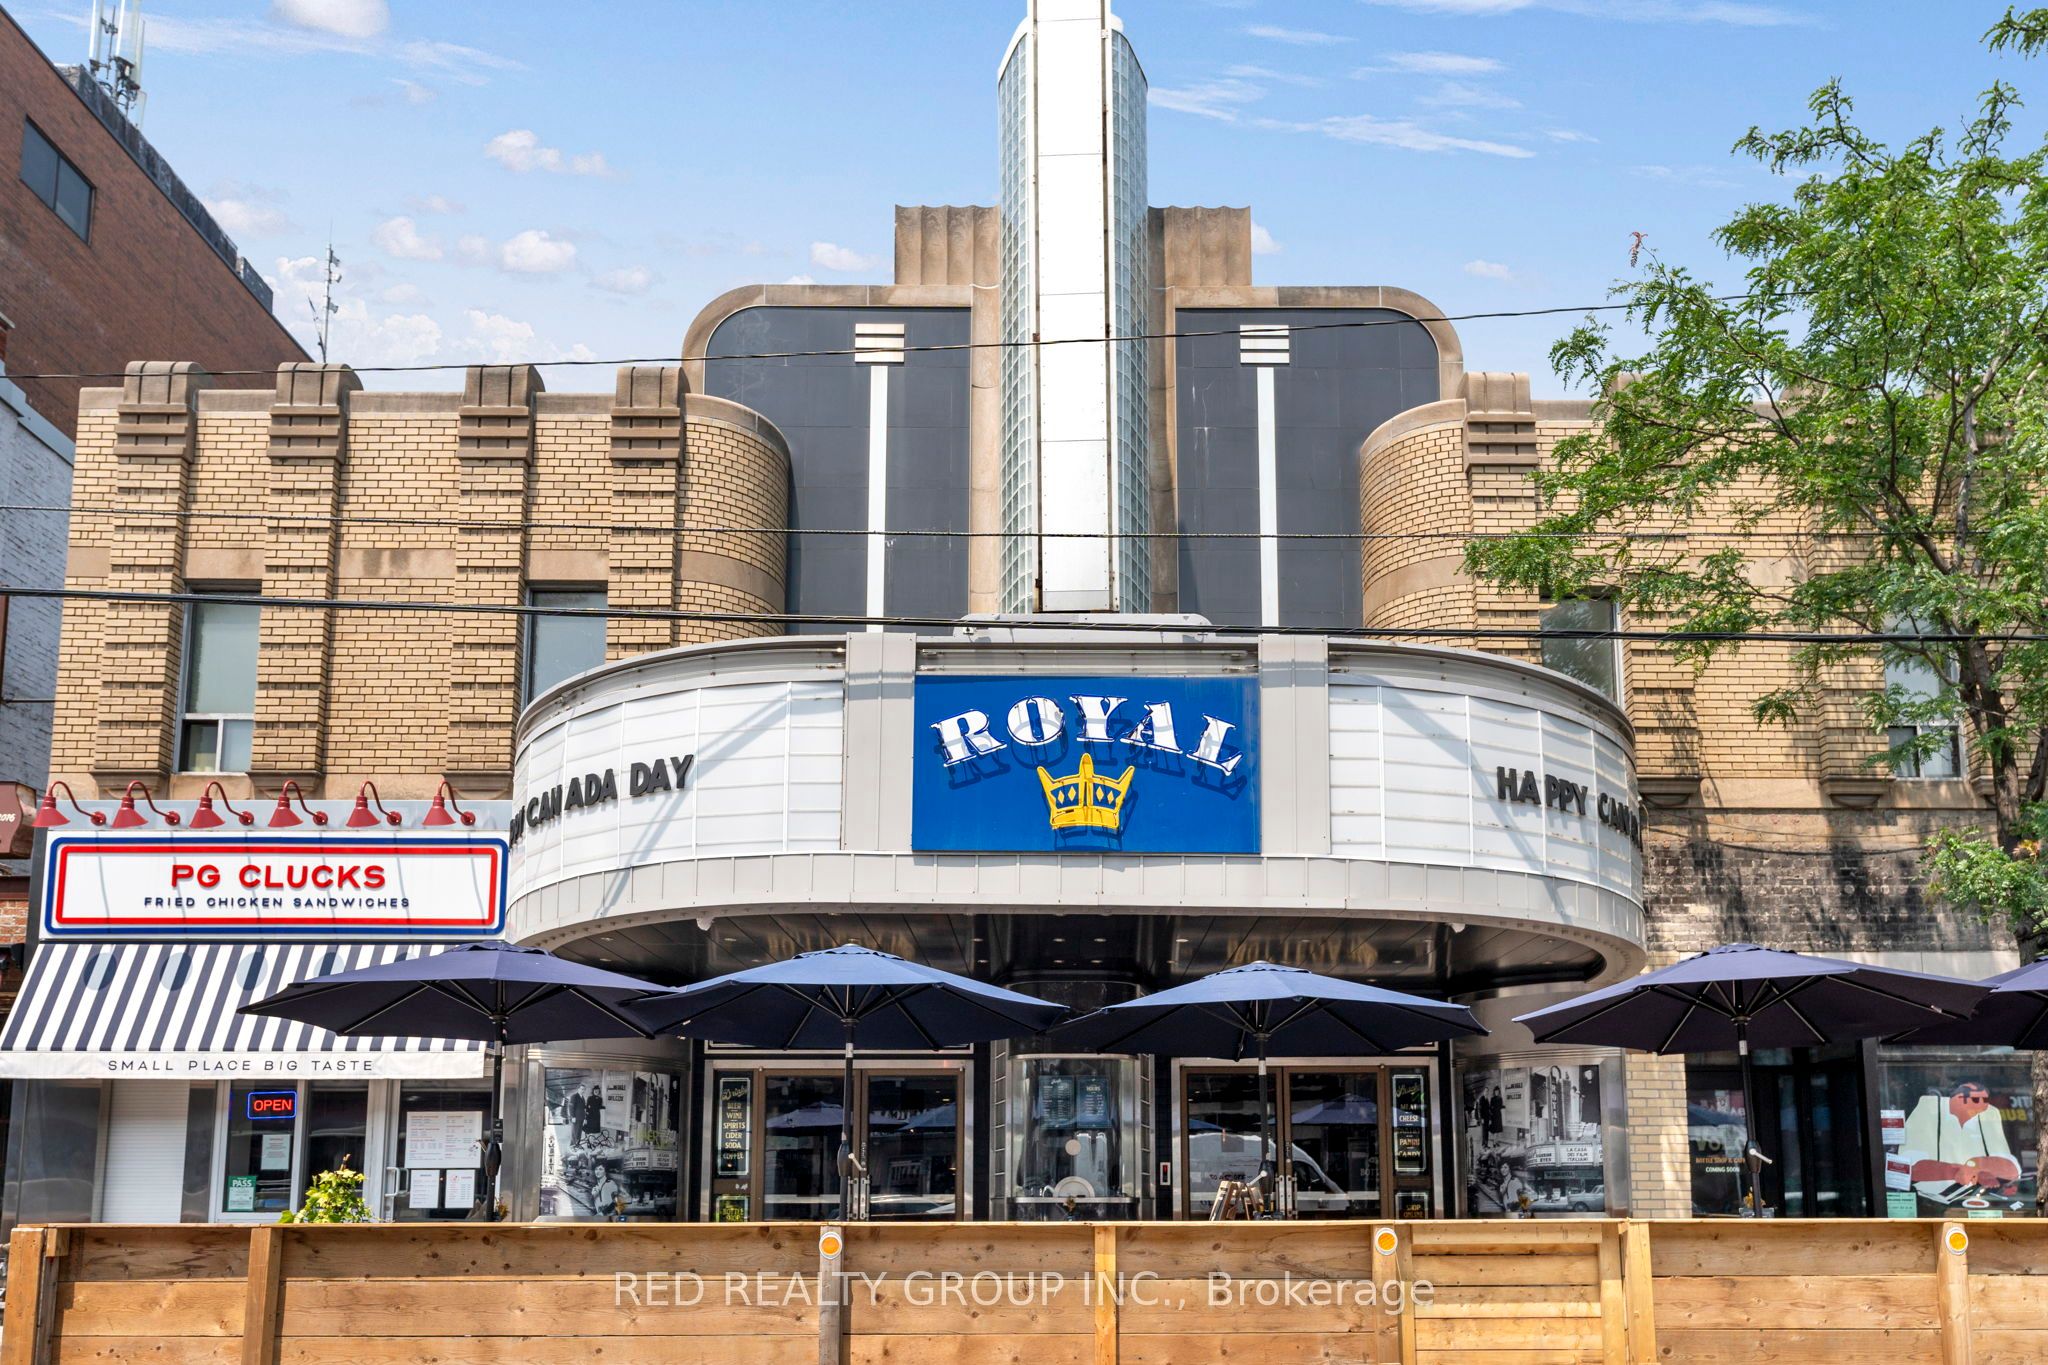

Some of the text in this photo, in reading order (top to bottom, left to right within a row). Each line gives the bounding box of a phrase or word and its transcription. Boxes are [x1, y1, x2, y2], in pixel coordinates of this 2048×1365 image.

[930, 693, 1244, 776] ROYAL
[526, 768, 618, 828] CANADA
[629, 754, 694, 797] DAY
[1496, 766, 1588, 816] HAPPY
[171, 864, 386, 889] PG CLUCKS
[144, 896, 411, 908] FRIED CHICKEN SANDWICHES
[108, 1059, 374, 1072] SMALL PLACE BIG TASTE
[253, 1099, 293, 1112] OPEN
[726, 1112, 742, 1120] WINE
[723, 1122, 746, 1130] SPIRITS
[232, 1179, 252, 1188] PASS
